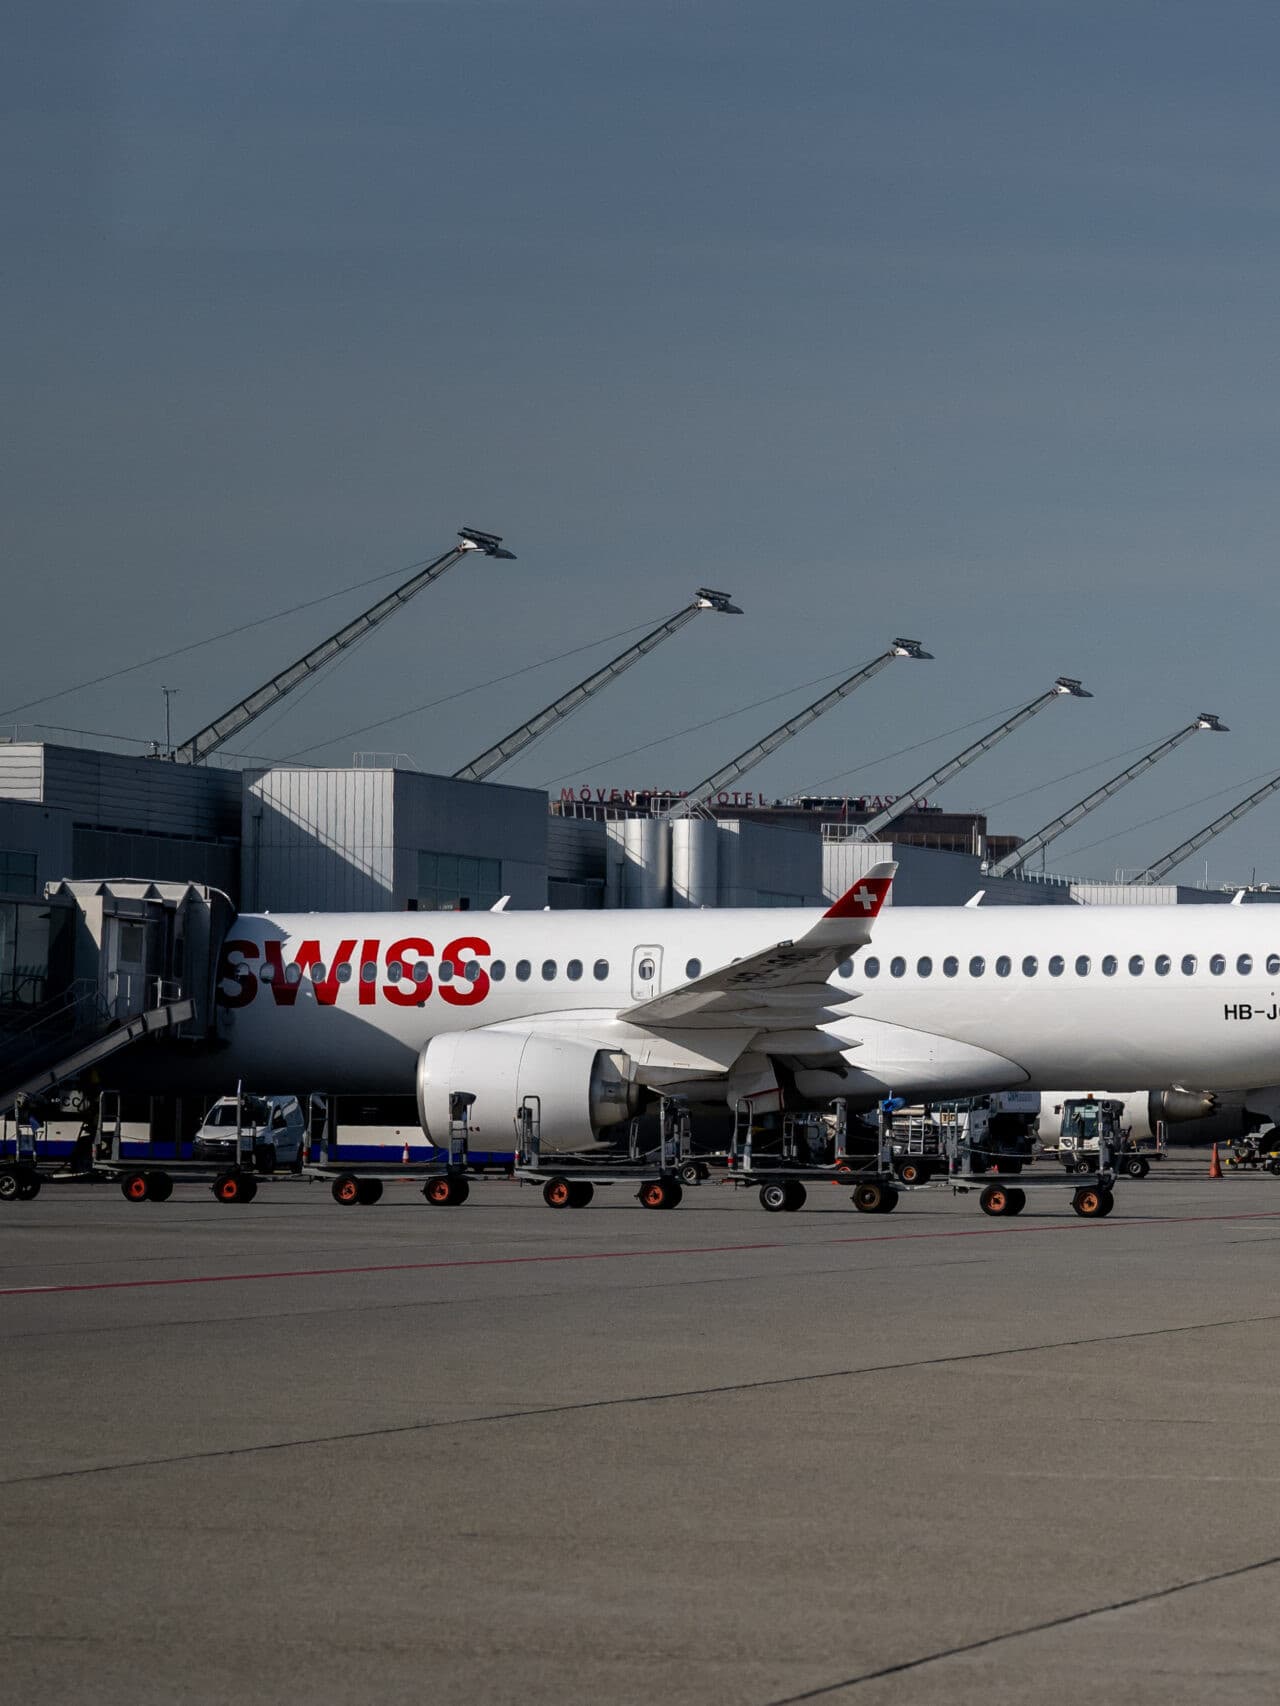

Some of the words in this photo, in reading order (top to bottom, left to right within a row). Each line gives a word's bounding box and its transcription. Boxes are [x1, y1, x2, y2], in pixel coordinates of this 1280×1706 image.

[706, 791, 766, 806] OTEL
[860, 795, 928, 809] CASO
[215, 937, 491, 1008] SWISS
